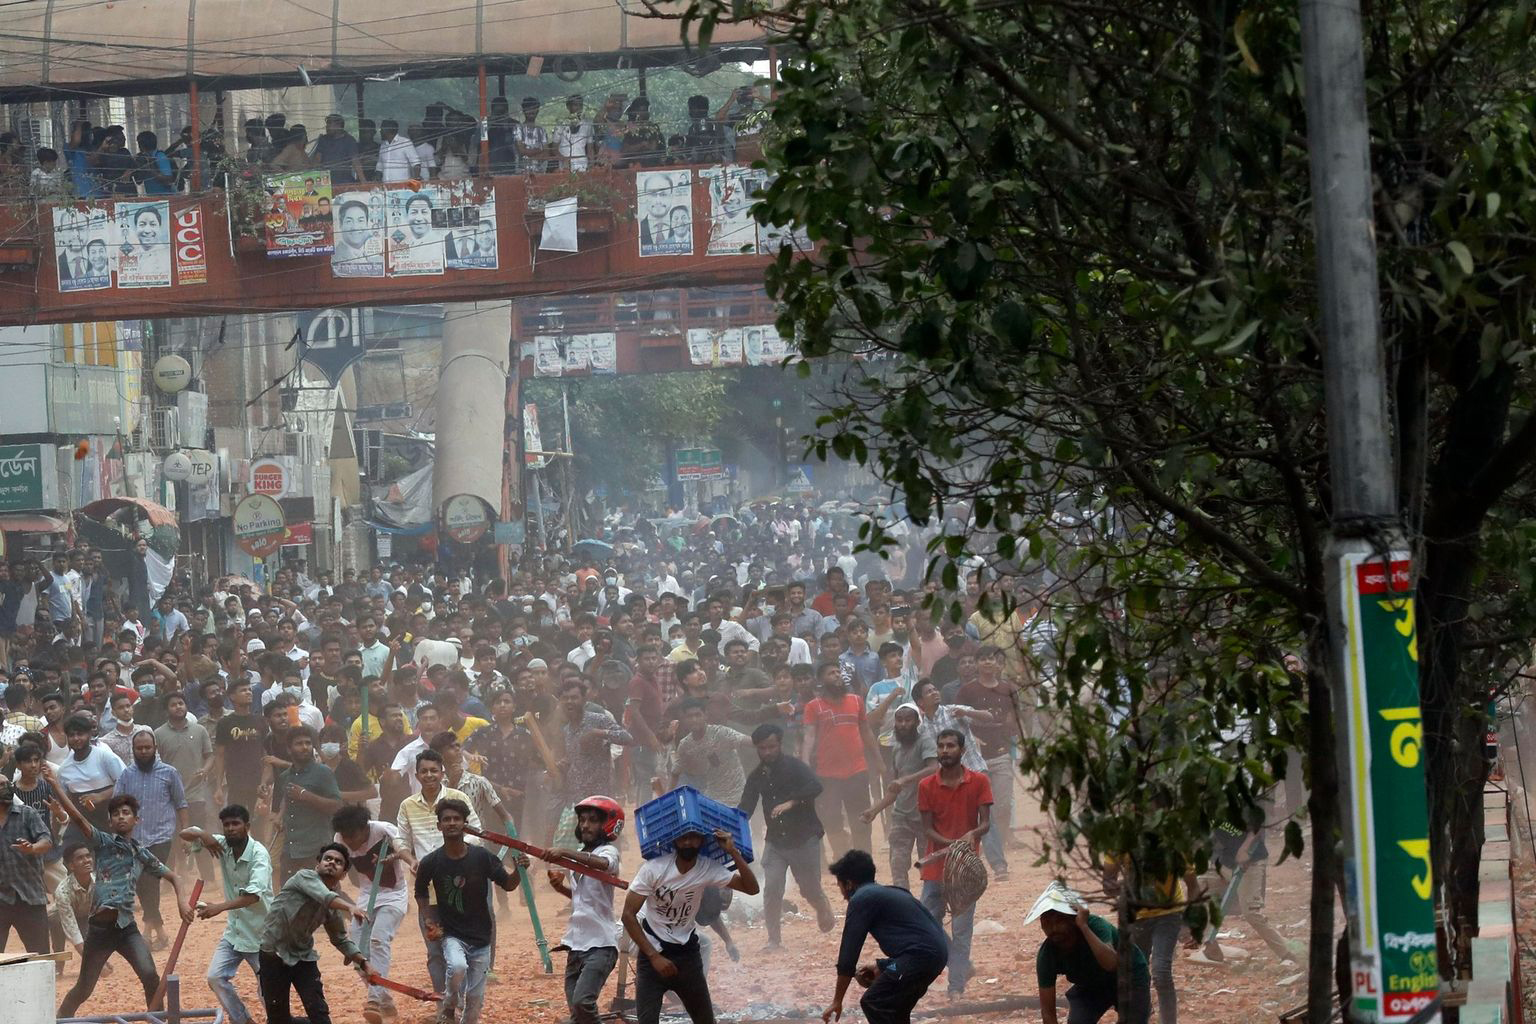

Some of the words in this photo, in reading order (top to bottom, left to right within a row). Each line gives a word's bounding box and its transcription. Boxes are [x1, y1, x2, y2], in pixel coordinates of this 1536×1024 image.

[177, 210, 203, 261] UCC
[255, 481, 282, 489] KING
[237, 523, 249, 532] No
[249, 519, 281, 529] Parking
